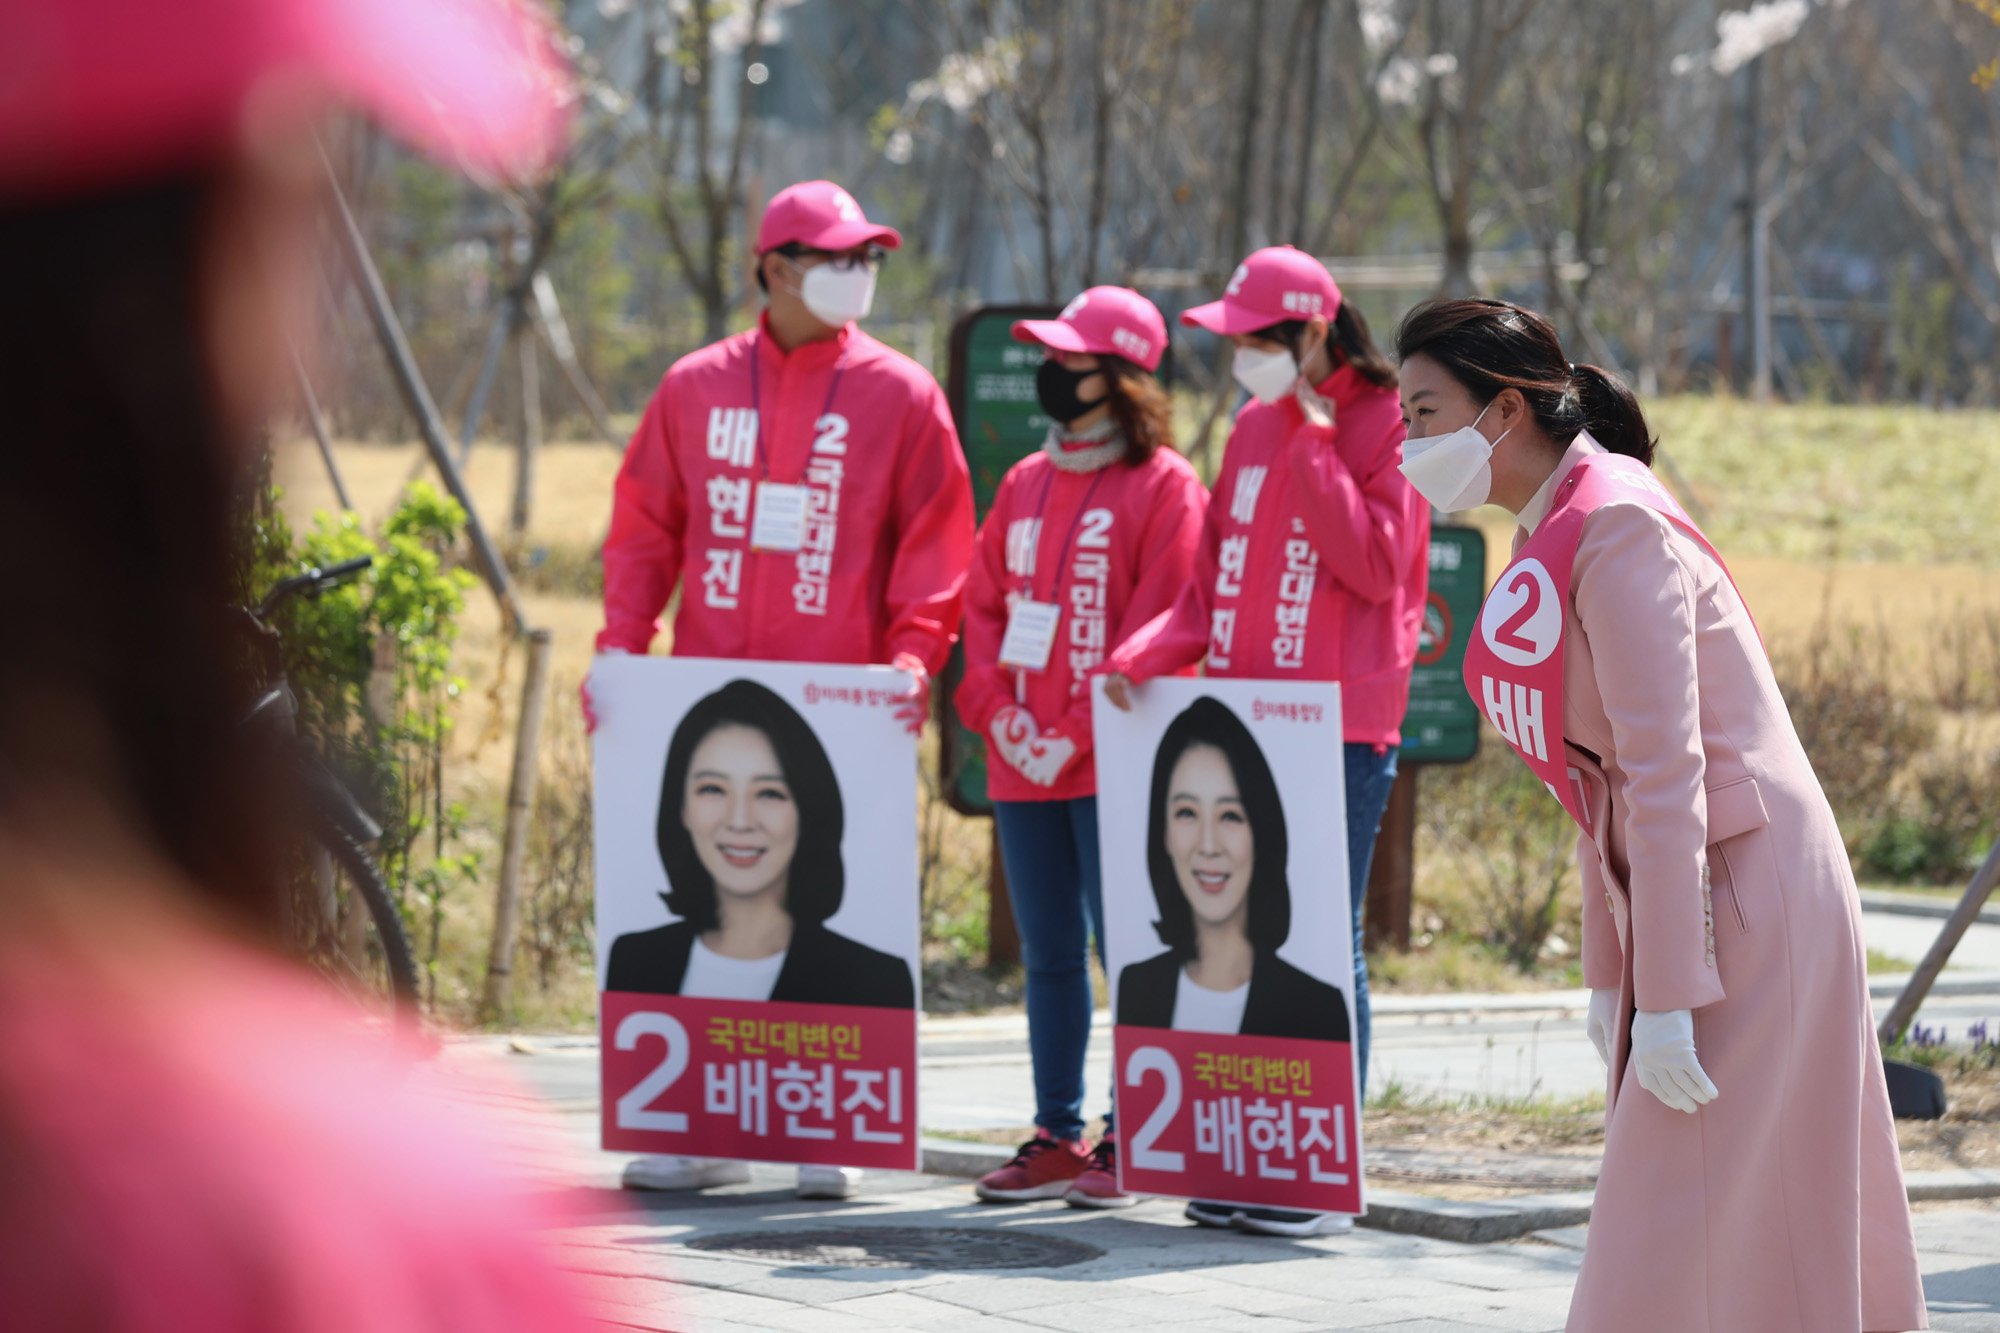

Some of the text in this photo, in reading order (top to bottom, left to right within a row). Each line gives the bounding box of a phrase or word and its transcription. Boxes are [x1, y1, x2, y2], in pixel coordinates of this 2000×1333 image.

[813, 413, 850, 456] 2
[702, 406, 759, 610] 배현진
[1076, 507, 1115, 549] 2
[1271, 517, 1320, 669] 민대변인
[1494, 571, 1542, 654] 2
[613, 1011, 690, 1132] 2
[706, 1016, 862, 1061] 국민대변인
[1193, 1052, 1313, 1097] 국민대변인
[704, 1059, 904, 1144] 배현진
[1125, 1045, 1186, 1173] 2
[1193, 1095, 1350, 1186] 배현진
